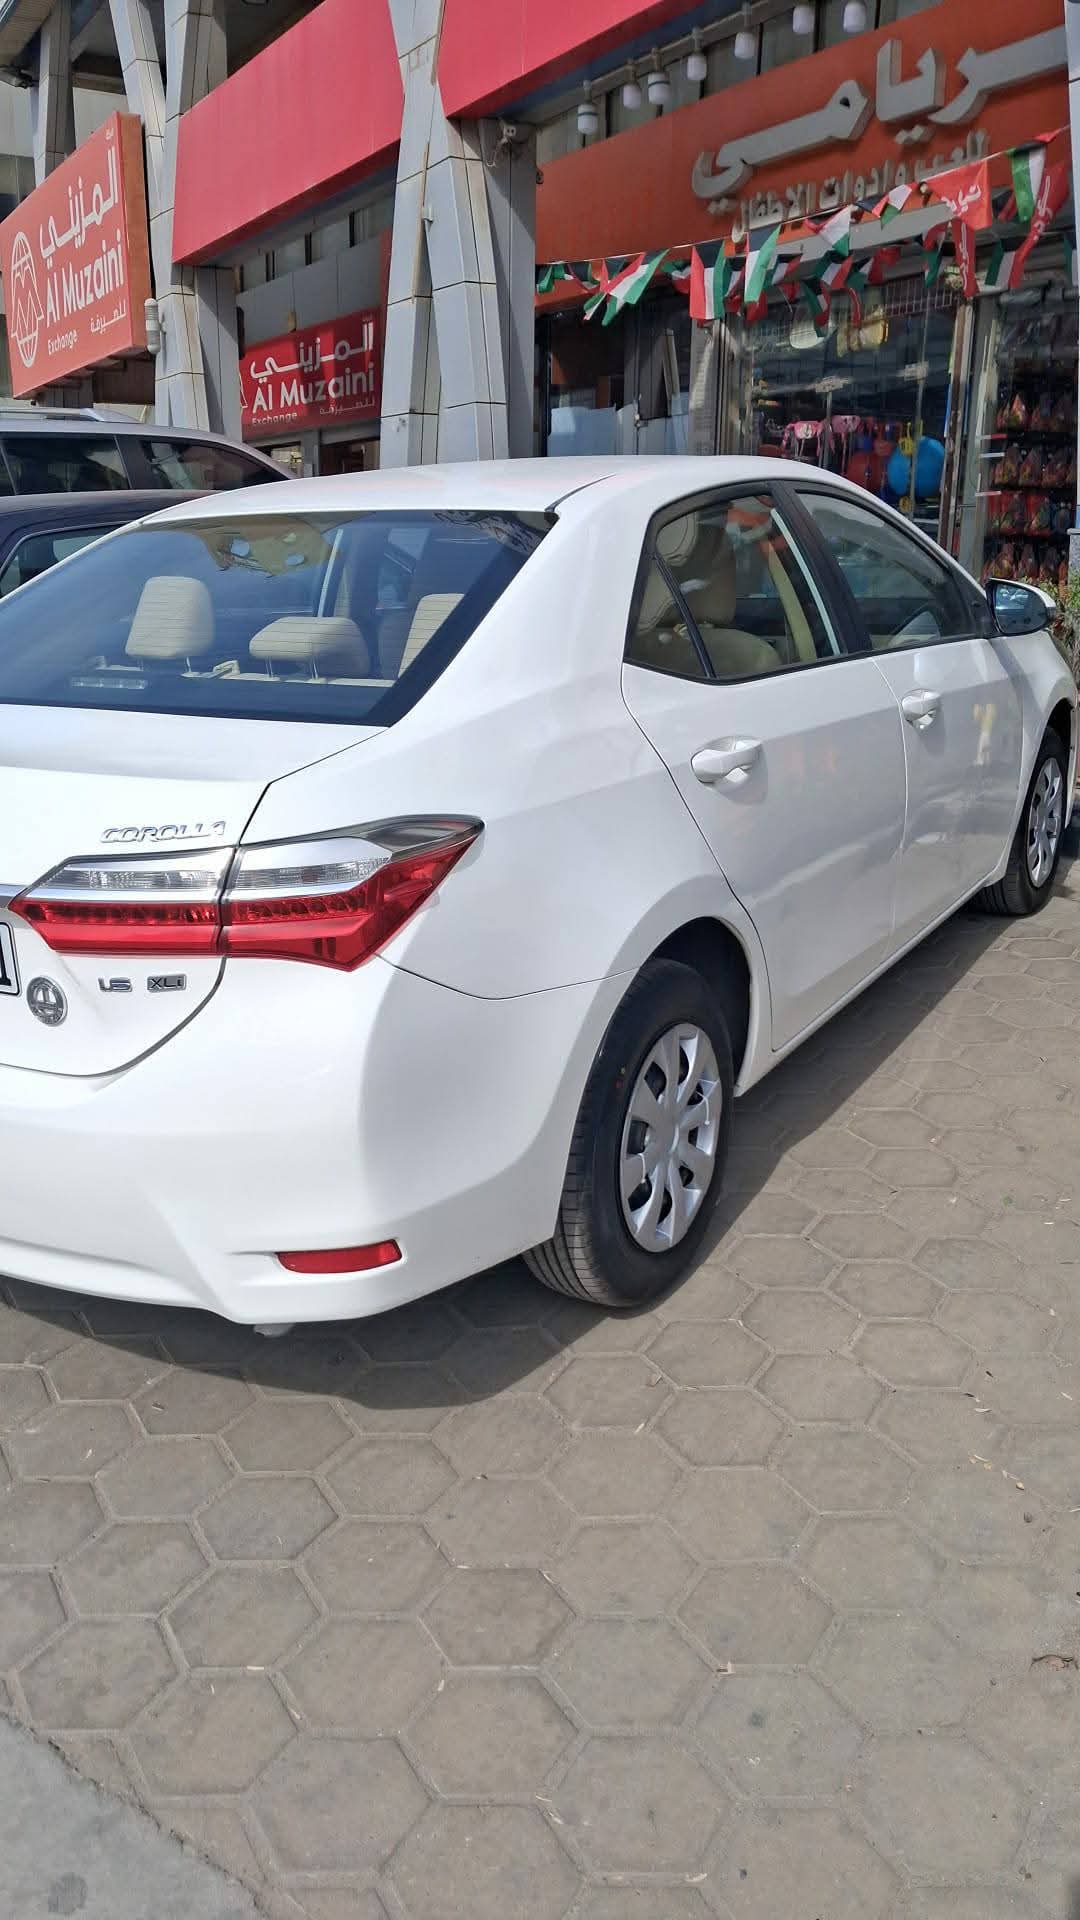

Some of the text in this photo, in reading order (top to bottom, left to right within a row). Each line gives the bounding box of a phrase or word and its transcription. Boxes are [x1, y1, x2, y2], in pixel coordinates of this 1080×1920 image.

[691, 24, 1067, 215] ريامي
[39, 145, 119, 269] المزيني
[46, 229, 125, 329] Al Muzaini
[47, 329, 78, 356] Exchange
[250, 321, 374, 384] المزيني
[251, 411, 298, 426] Exchange
[252, 362, 375, 414] Al Muzaini
